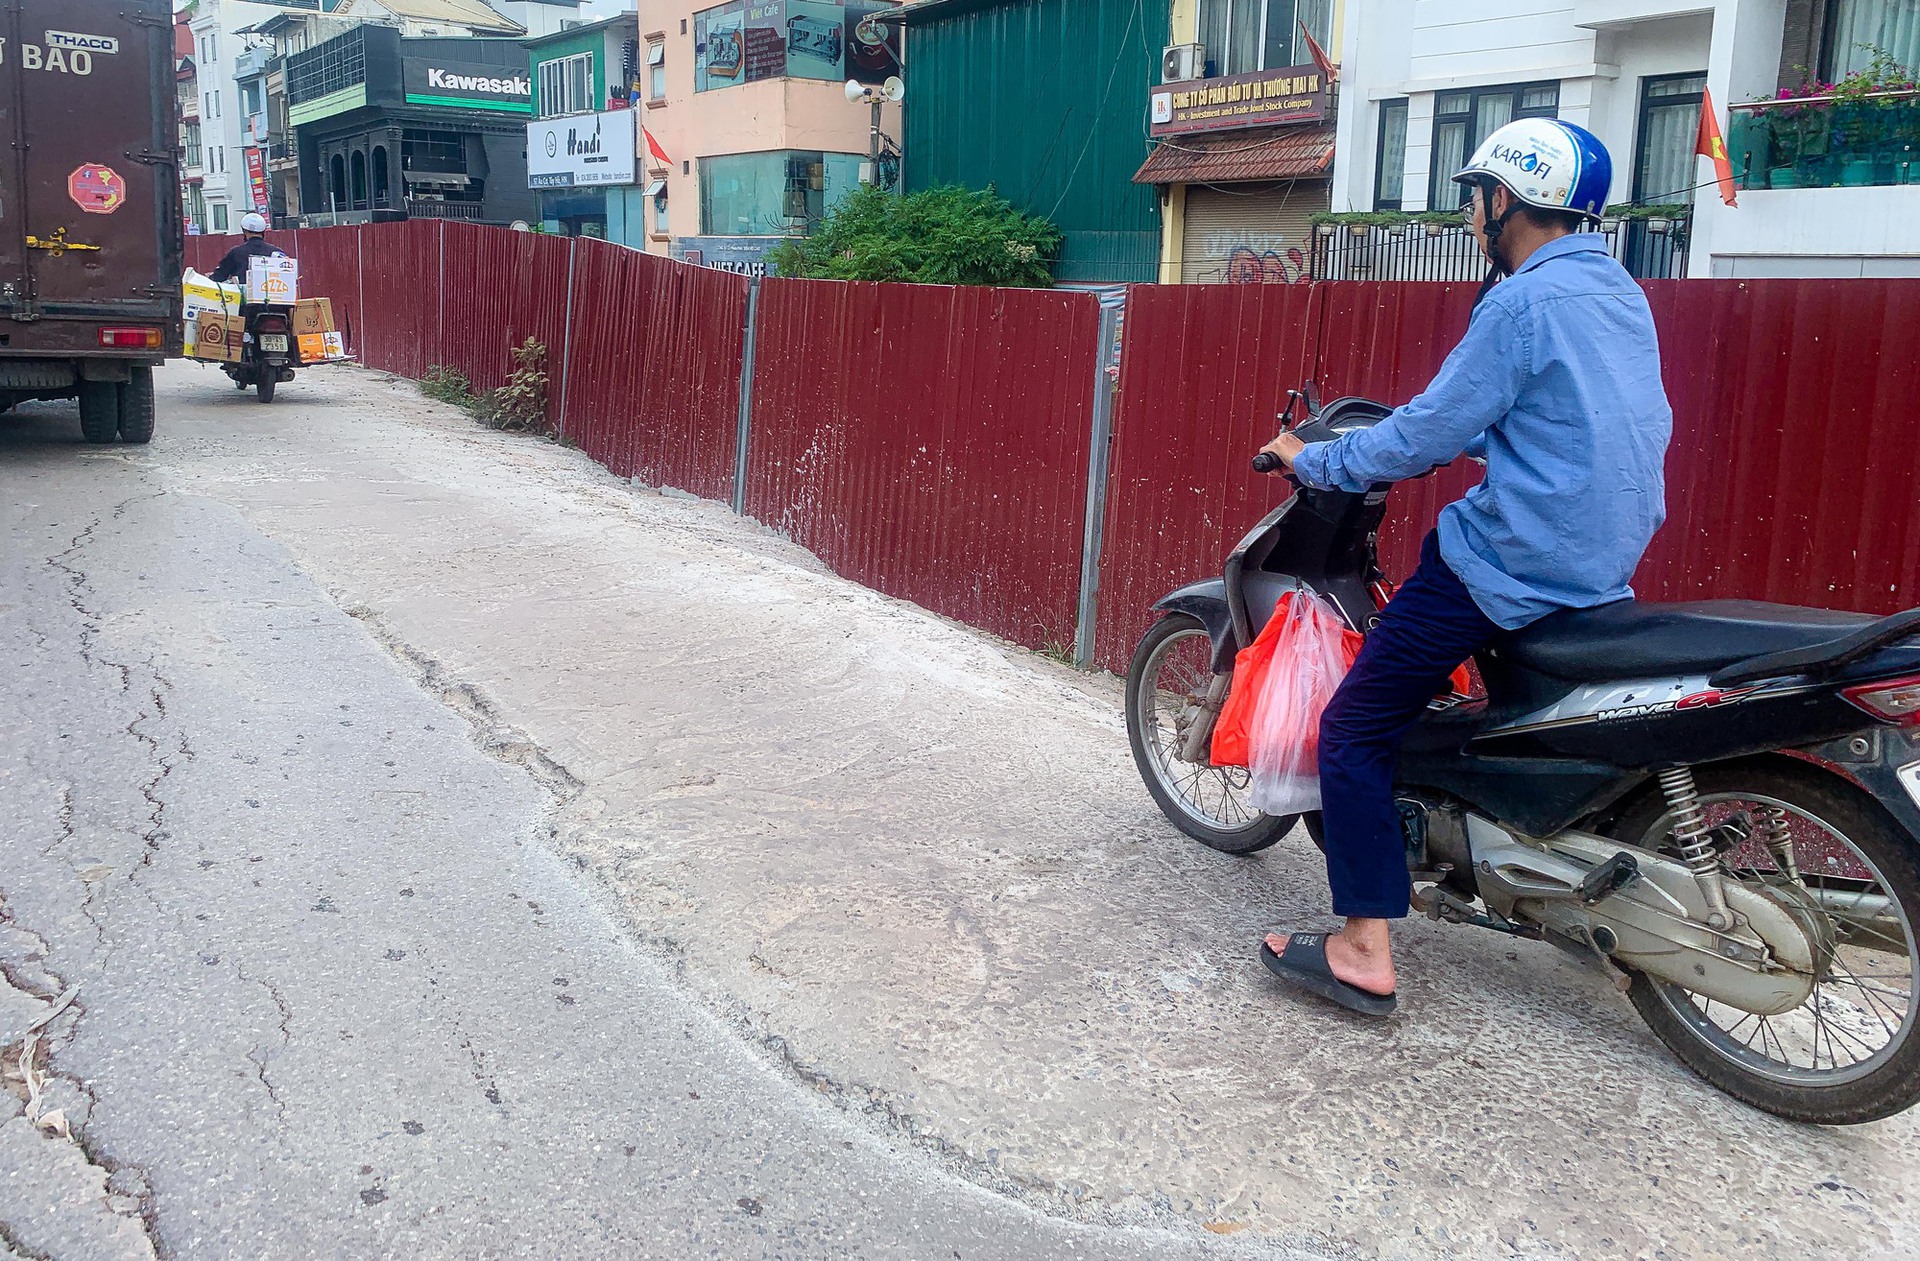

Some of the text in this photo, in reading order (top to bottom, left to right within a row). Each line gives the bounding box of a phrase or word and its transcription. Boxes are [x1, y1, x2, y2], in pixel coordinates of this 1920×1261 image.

[52, 34, 113, 50] THACO
[428, 68, 531, 96] Kawasaki
[1190, 90, 1198, 107] TY
[1308, 74, 1319, 92] HK
[1178, 112, 1187, 120] HK
[1190, 109, 1220, 120] Investment
[1221, 106, 1232, 116] and
[1234, 104, 1249, 114] Trade
[1265, 100, 1283, 111] Stock
[1284, 99, 1313, 110] Company
[567, 114, 601, 156] Handi
[1490, 144, 1552, 180] KAROFI
